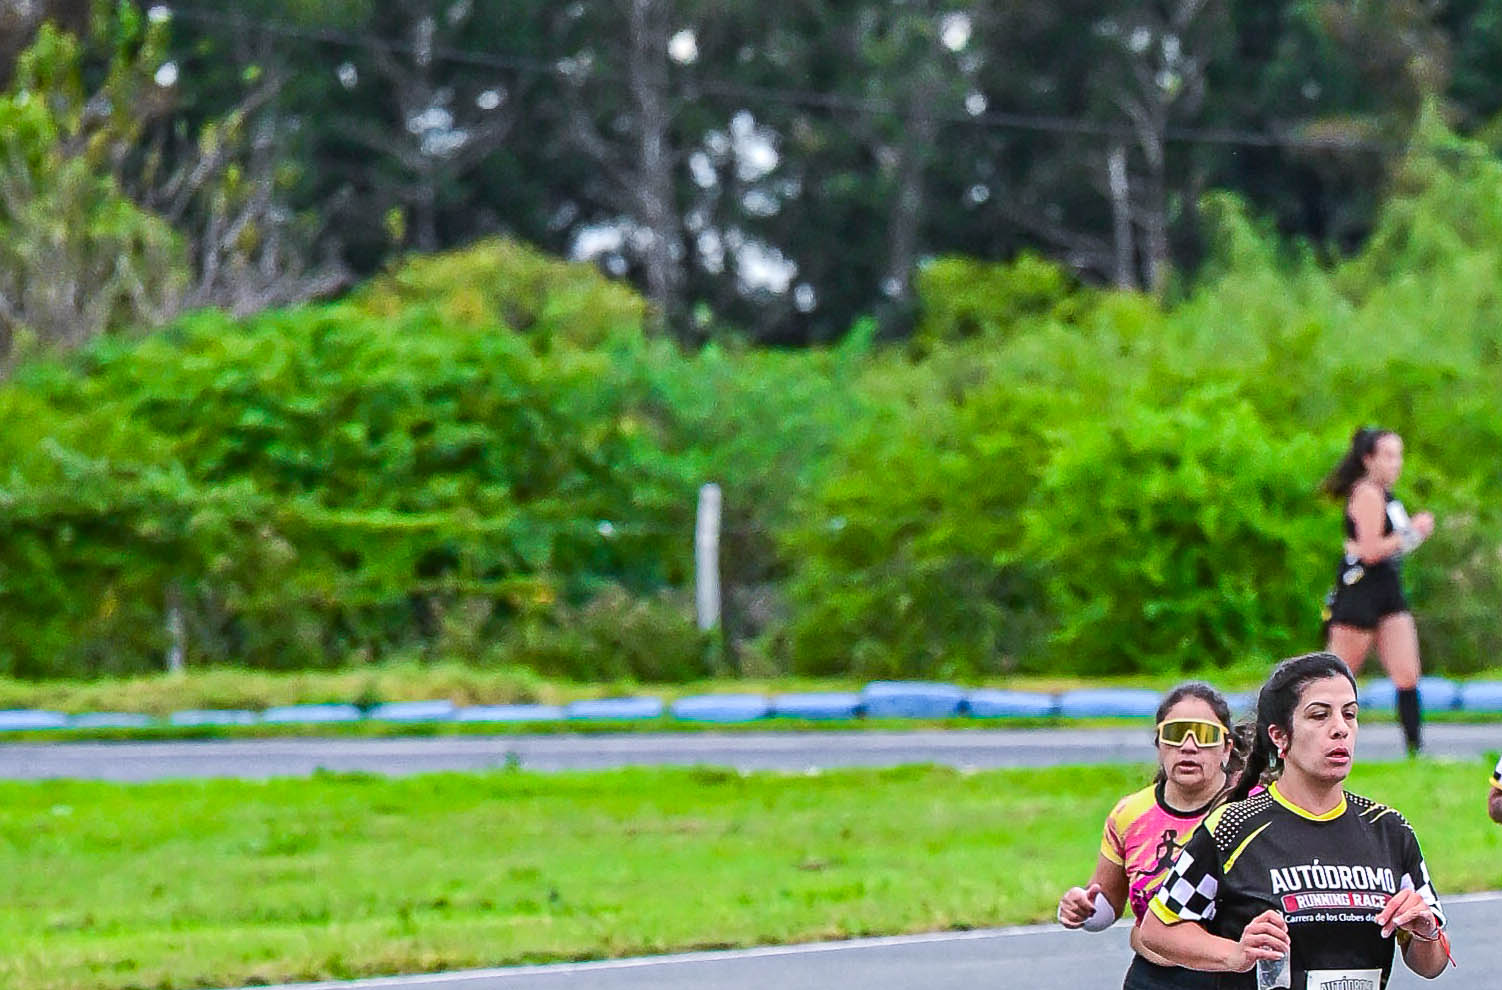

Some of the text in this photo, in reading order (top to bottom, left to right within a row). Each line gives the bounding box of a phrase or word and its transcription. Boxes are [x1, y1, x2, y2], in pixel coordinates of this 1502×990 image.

[1269, 858, 1396, 895] AUTÓDROMO
[1295, 893, 1387, 909] RUNNING RACE
[1284, 914, 1314, 923] Carrera
[1315, 912, 1326, 922] de
[1326, 912, 1338, 922] los
[1338, 913, 1365, 922] Clubes
